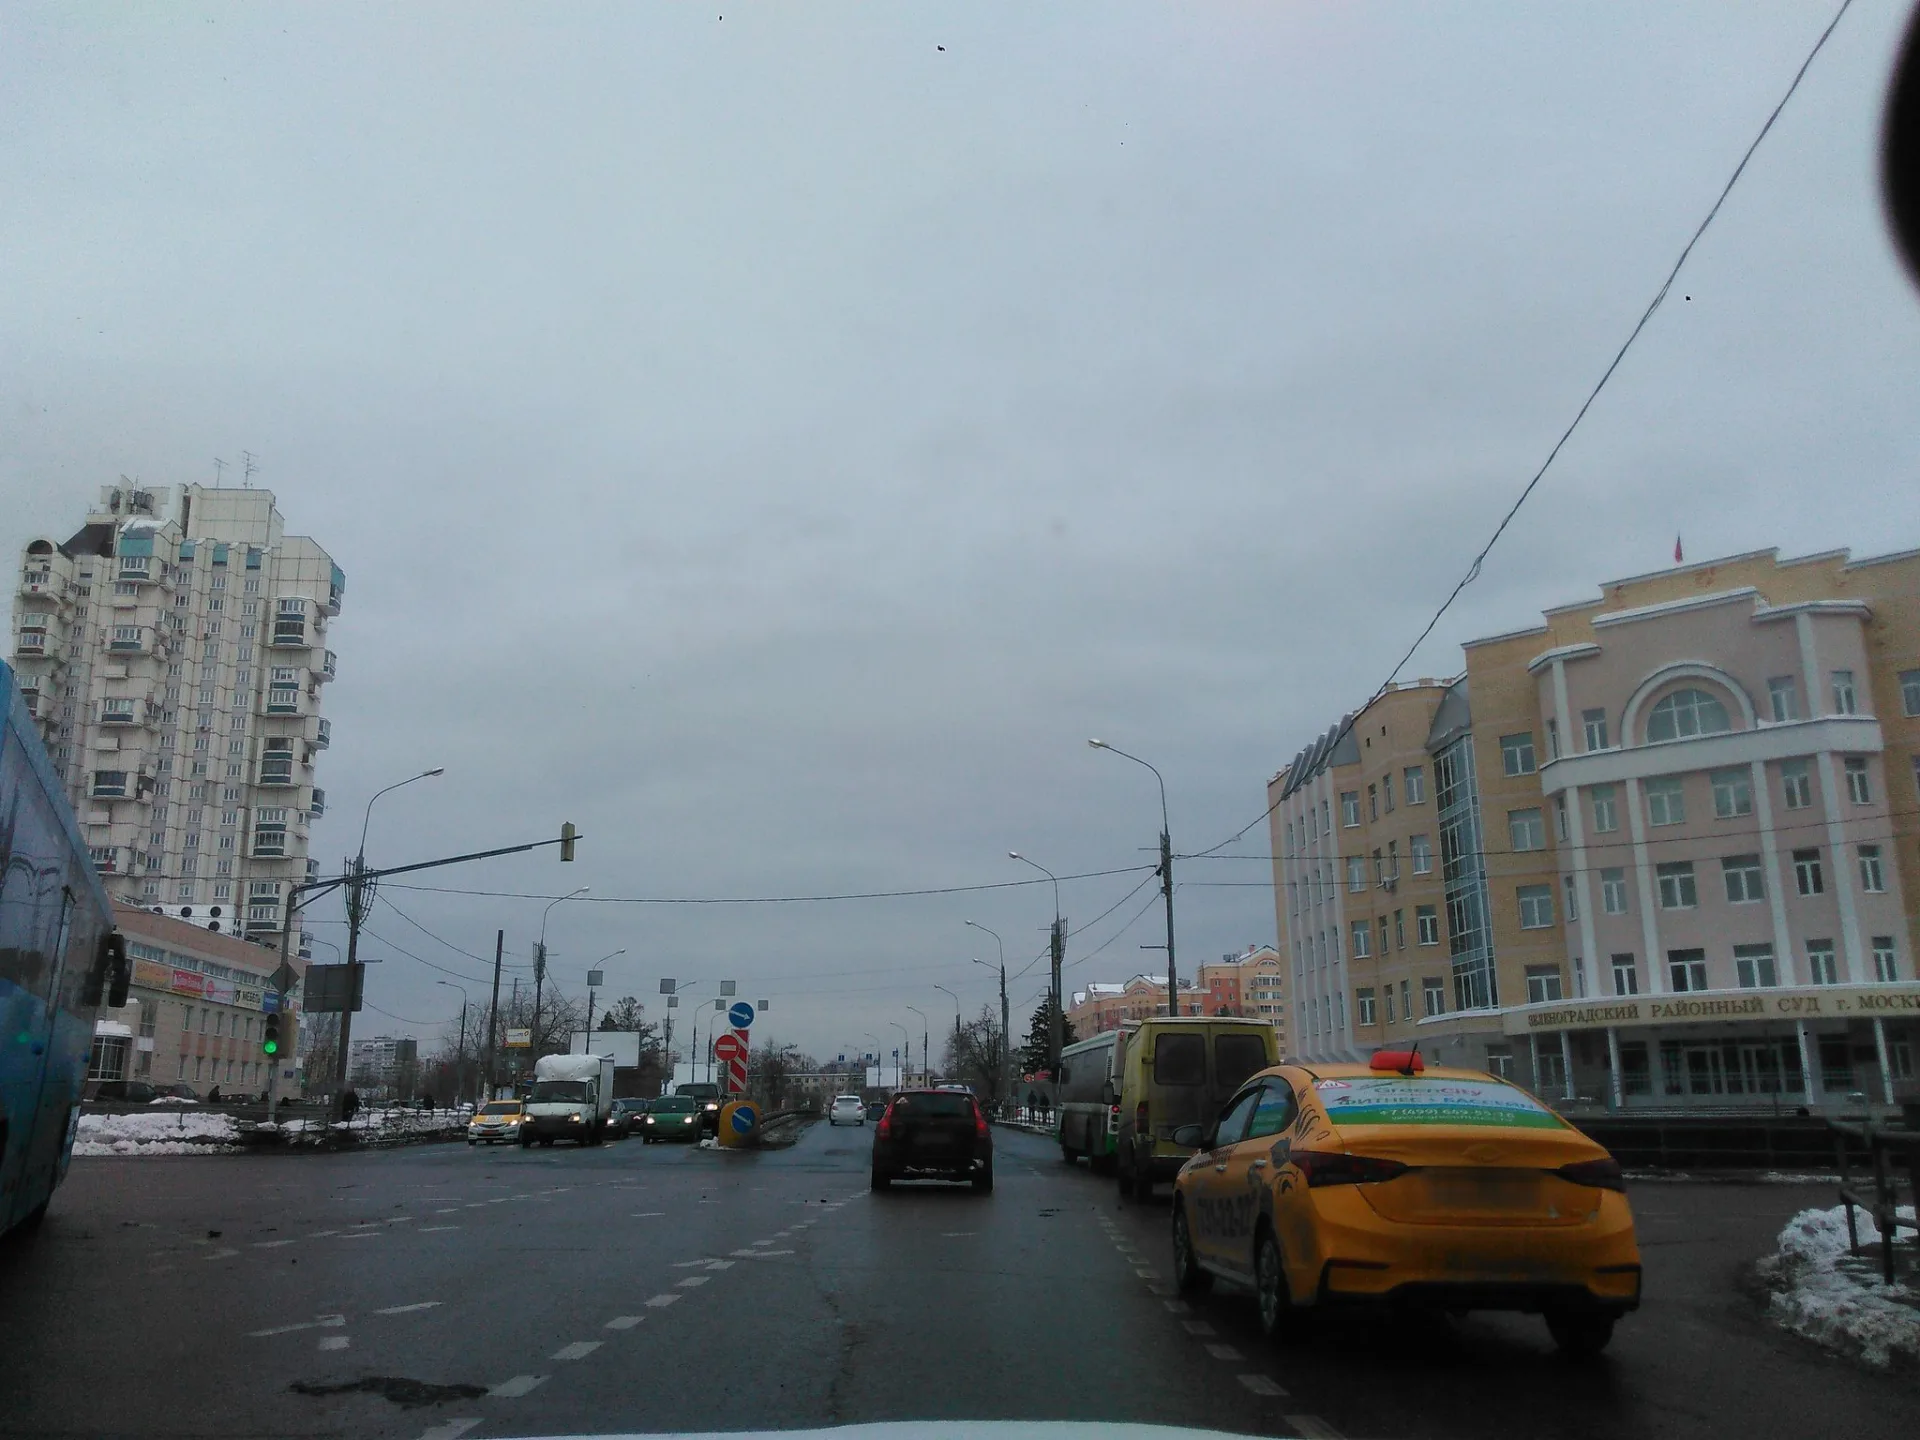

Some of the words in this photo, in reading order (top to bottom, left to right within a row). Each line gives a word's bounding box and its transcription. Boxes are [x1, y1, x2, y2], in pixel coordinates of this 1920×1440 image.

[1528, 1004, 1639, 1027] ЗЕЛЕНОГРАДСКИЙ
[1651, 996, 1765, 1018] РАЙОННЫЙ
[1777, 995, 1820, 1013] СУД
